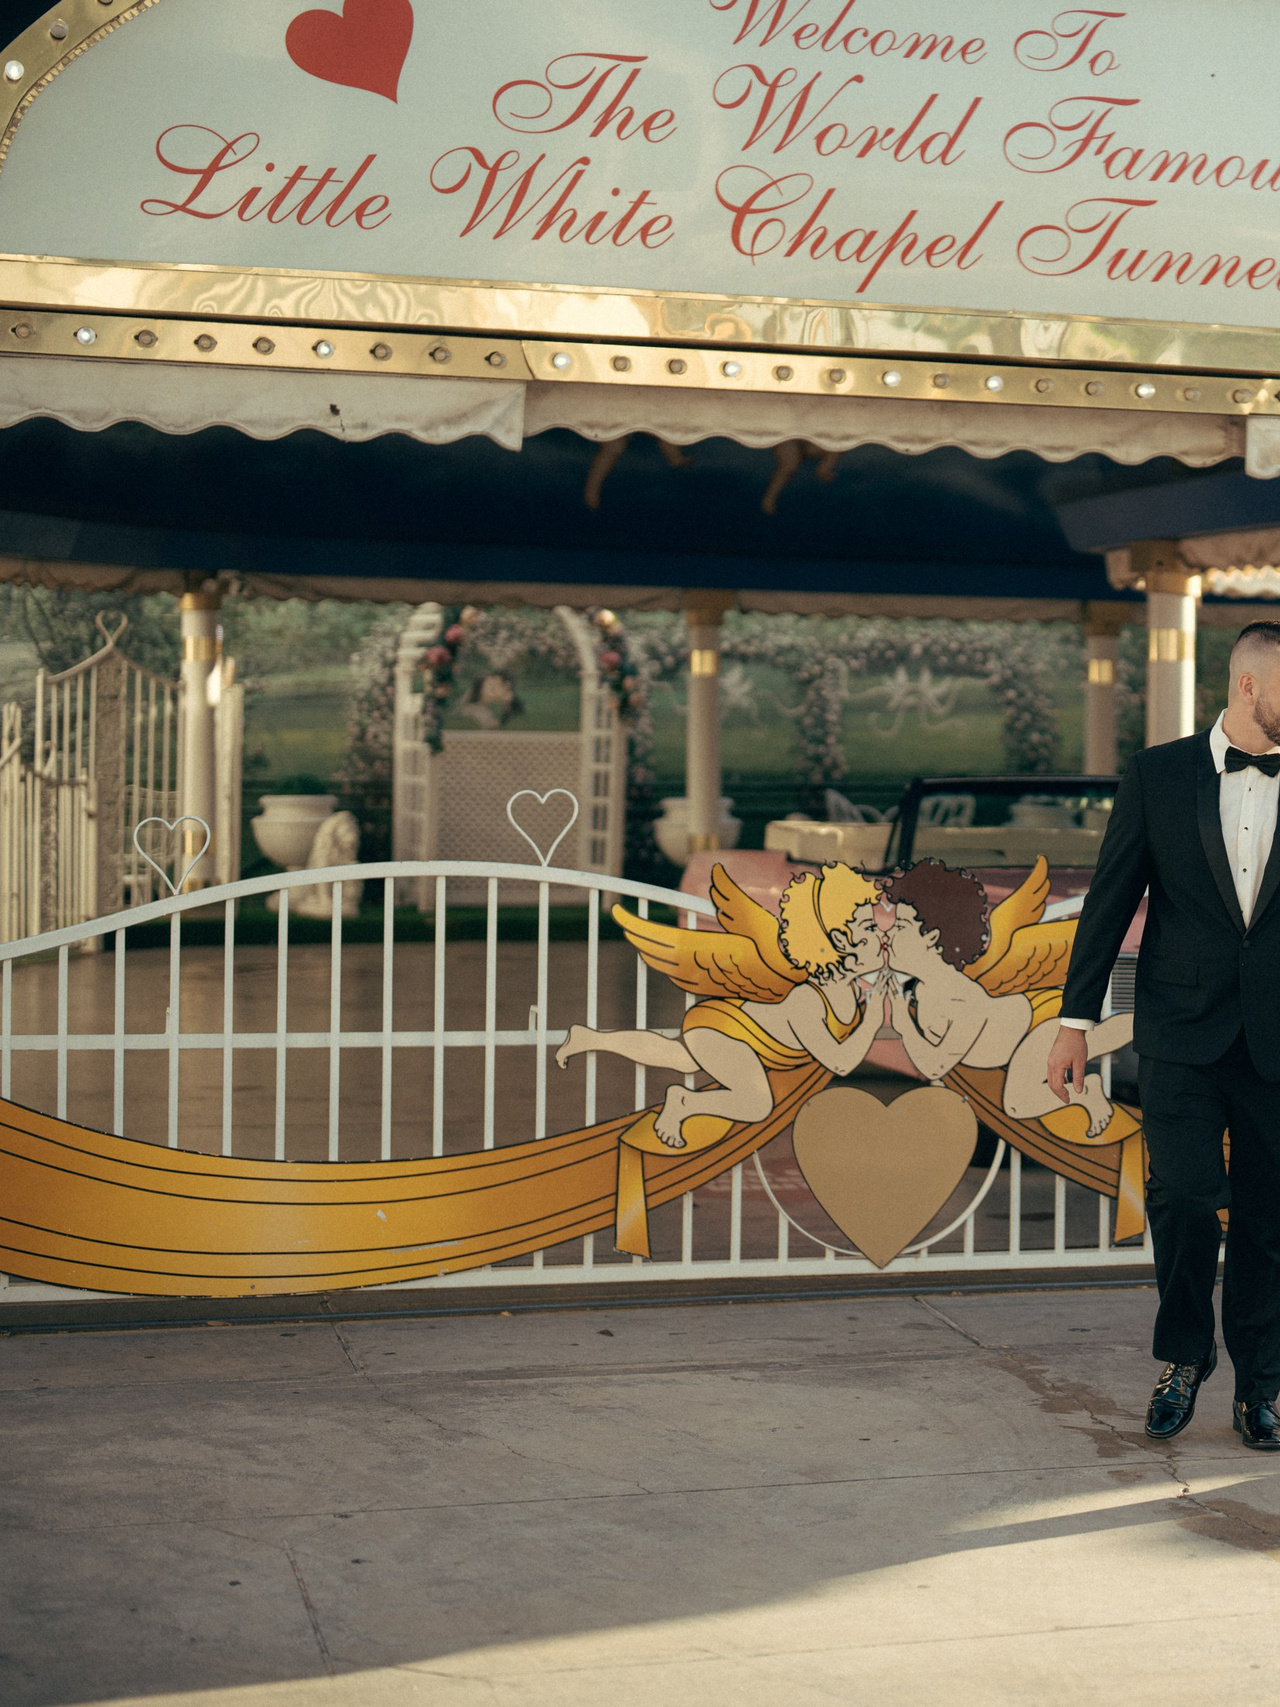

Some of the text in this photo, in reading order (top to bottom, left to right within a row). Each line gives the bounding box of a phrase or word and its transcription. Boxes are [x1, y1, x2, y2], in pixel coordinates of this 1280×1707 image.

[709, 0, 1127, 76] Welcome To
[492, 52, 677, 143] The
[713, 63, 984, 166] World
[140, 124, 392, 230] Little
[429, 146, 675, 249] White
[715, 164, 1004, 294] Chapel
